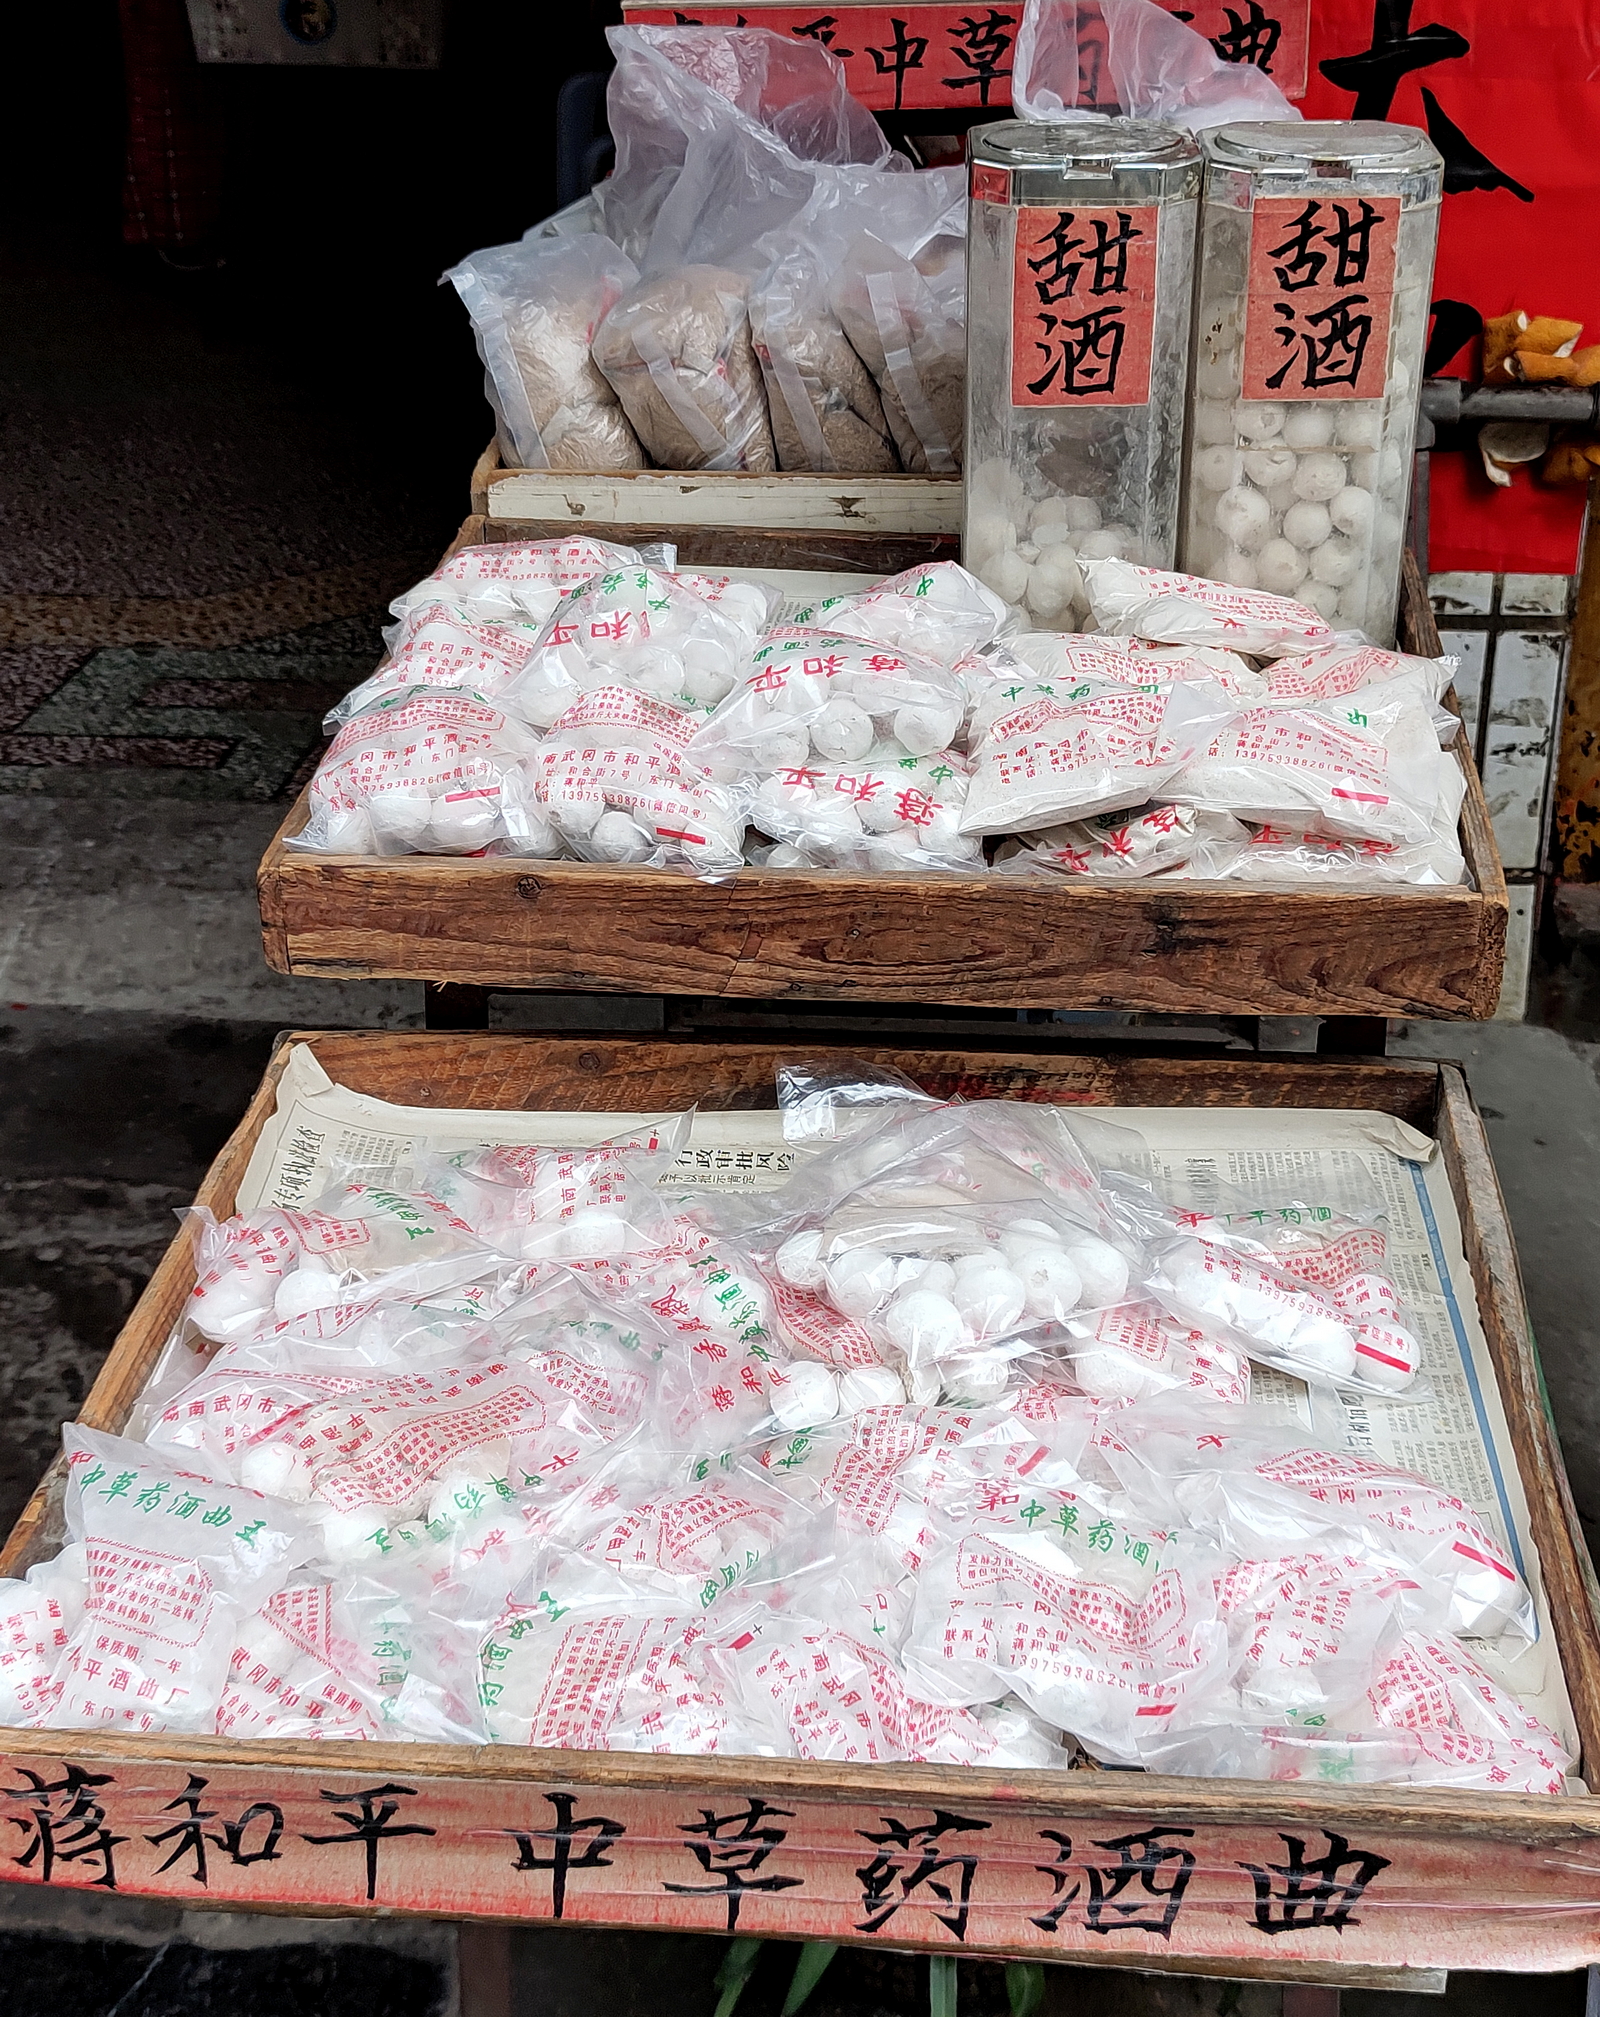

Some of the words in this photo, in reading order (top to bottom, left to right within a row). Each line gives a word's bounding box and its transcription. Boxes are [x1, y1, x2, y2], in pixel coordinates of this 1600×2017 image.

[1027, 211, 1143, 396] 甜酒
[1265, 199, 1386, 391] 甜酒
[96, 1633, 145, 1664] 保质期：
[153, 1657, 183, 1675] 一年
[0, 1762, 1392, 1943] 蒋和平中草药酒曲
